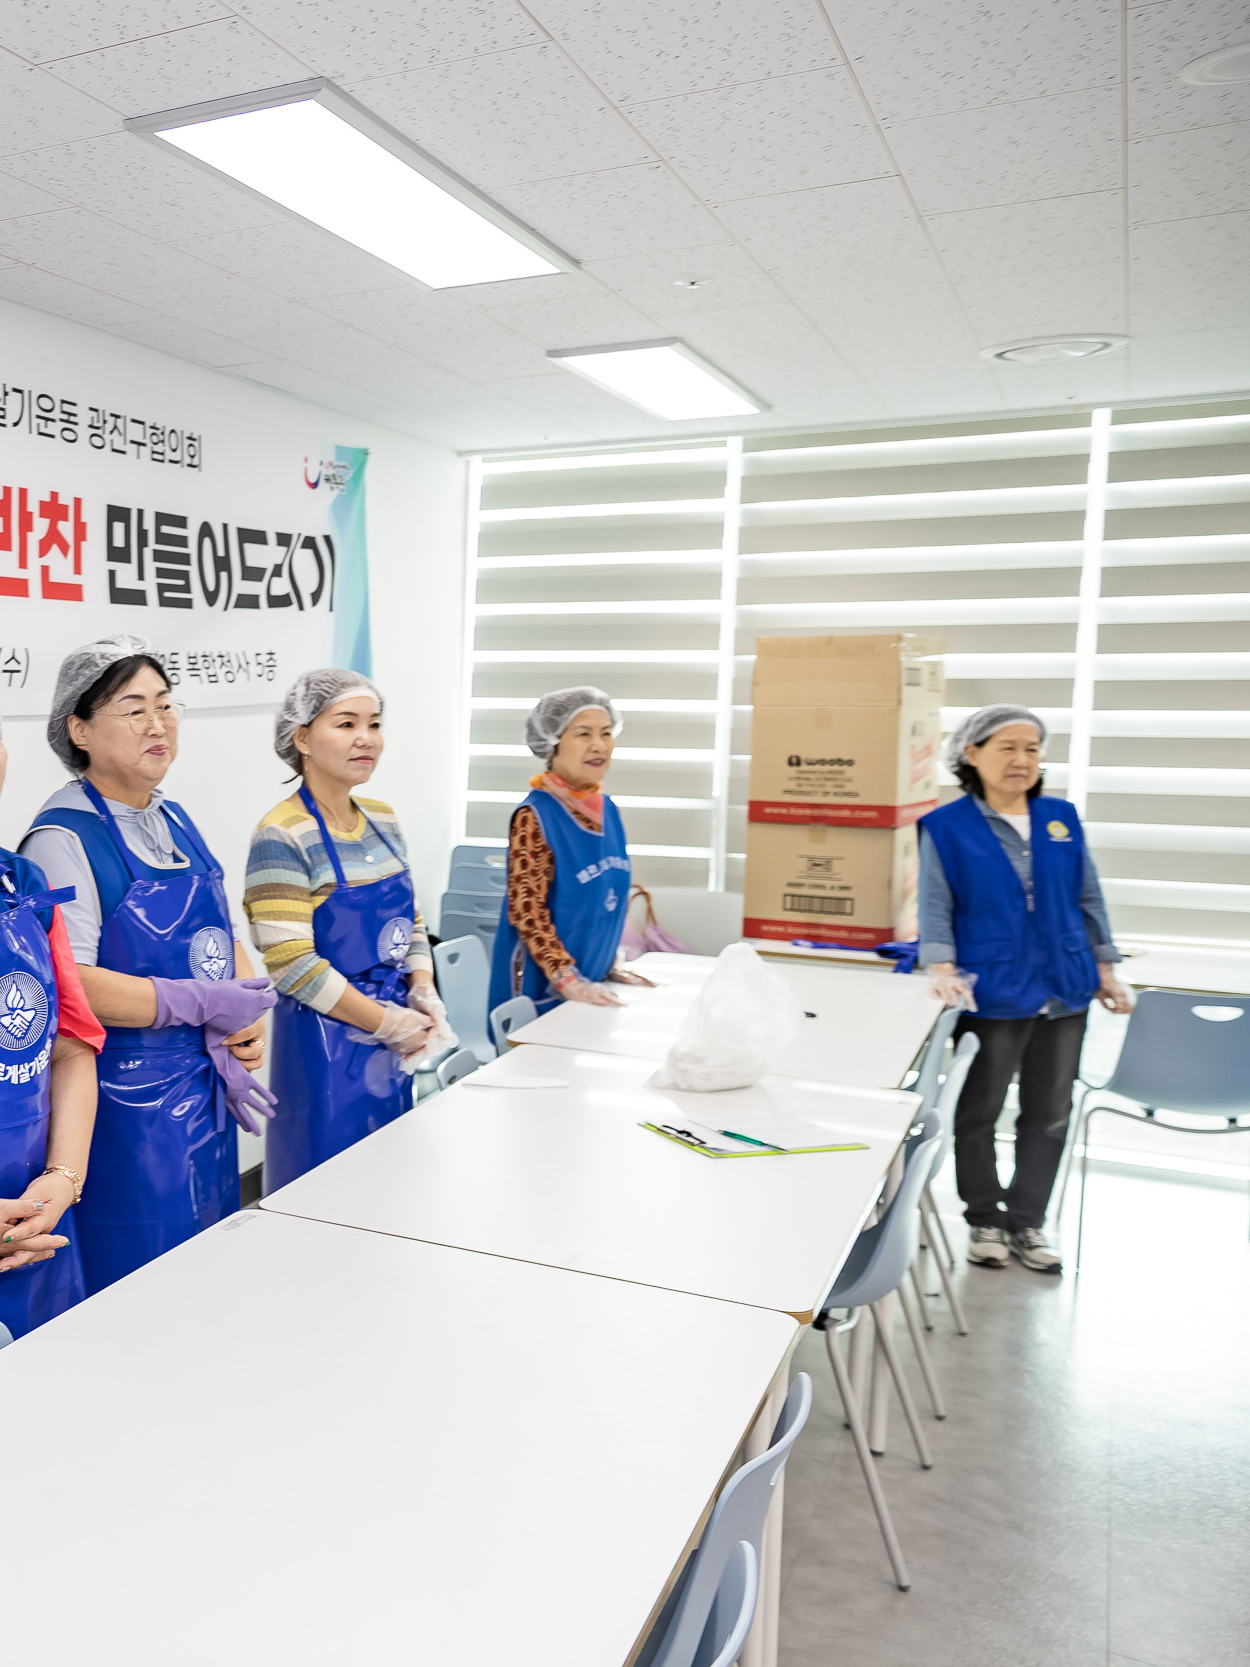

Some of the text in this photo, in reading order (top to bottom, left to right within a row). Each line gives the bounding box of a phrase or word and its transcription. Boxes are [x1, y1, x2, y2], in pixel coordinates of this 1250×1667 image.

[88, 406, 202, 472] 광진구협의회
[106, 504, 337, 613] 만들어드리기
[187, 651, 251, 685] 복합청사
[255, 650, 278, 682] 5층
